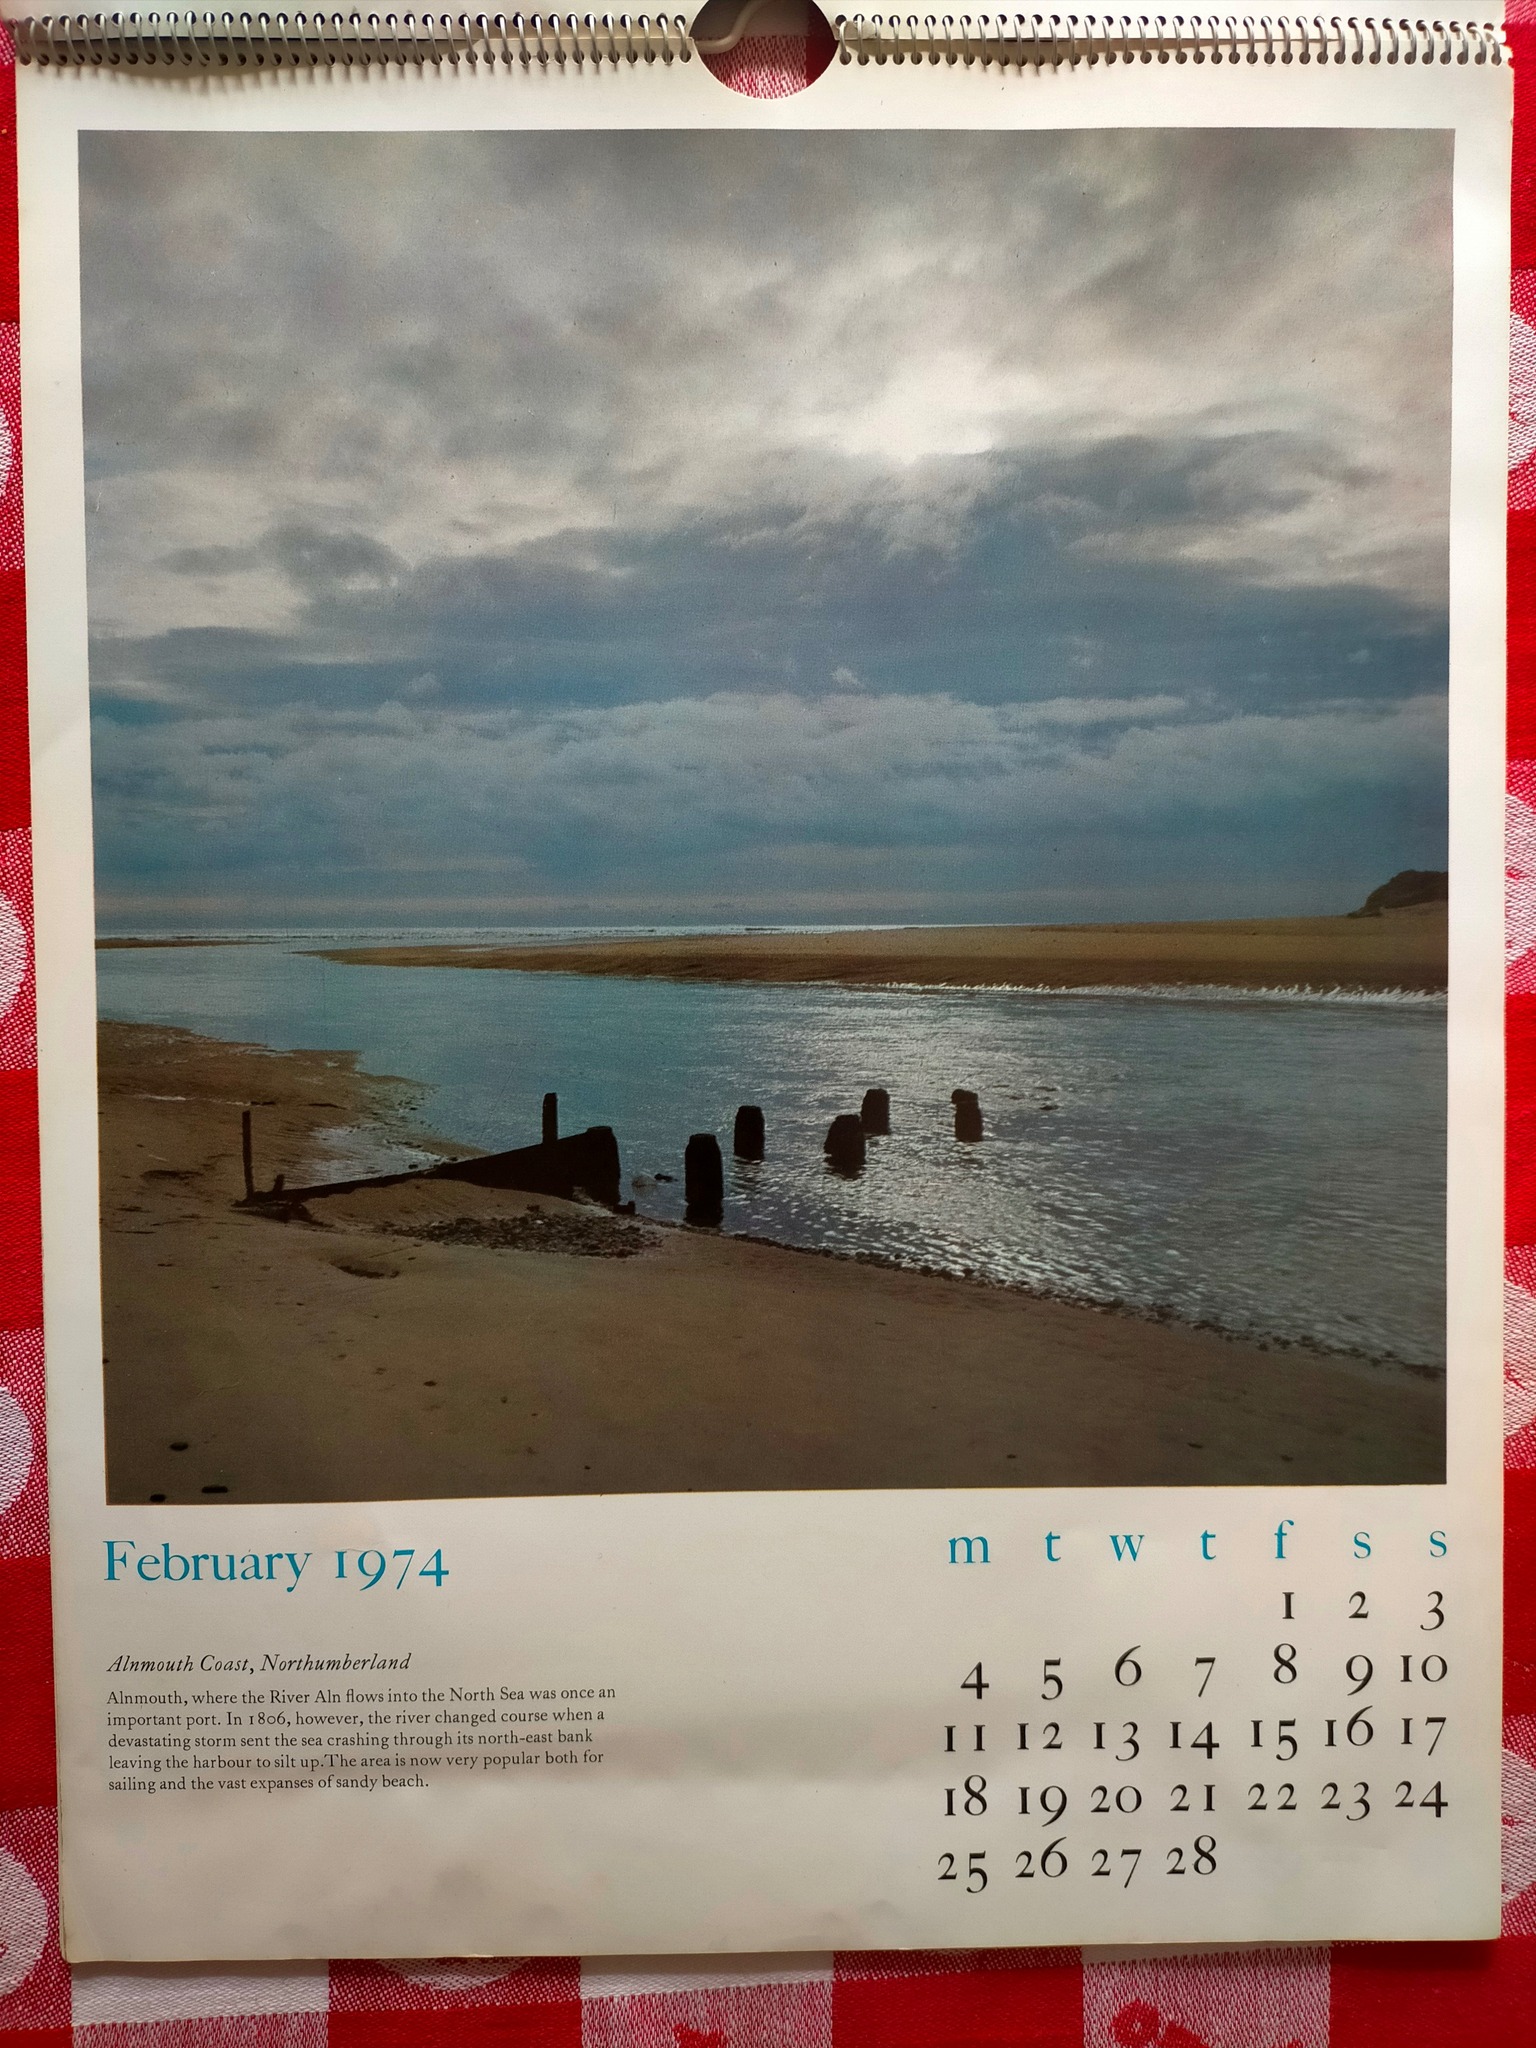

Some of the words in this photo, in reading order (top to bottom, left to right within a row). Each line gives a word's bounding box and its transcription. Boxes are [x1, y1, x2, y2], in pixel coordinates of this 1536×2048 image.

[948, 1536, 991, 1564] m
[1044, 1531, 1061, 1562] t
[1109, 1534, 1145, 1562] w
[1200, 1530, 1216, 1561] t
[1274, 1519, 1295, 1559] f
[1353, 1531, 1372, 1559] s
[1429, 1530, 1447, 1558] s
[103, 1540, 313, 1593] February
[335, 1547, 450, 1591] 1974
[1282, 1591, 1295, 1620] 1
[1348, 1590, 1369, 1619] 2
[1419, 1590, 1445, 1631] 3
[106, 1655, 194, 1672] Alnmouth
[200, 1654, 255, 1675] Coast,
[259, 1652, 412, 1672] Northumberland
[960, 1661, 990, 1700] 4
[1041, 1657, 1063, 1701] 5
[1114, 1645, 1142, 1687] 6
[1194, 1656, 1216, 1698] 7
[1273, 1643, 1298, 1685] 8
[1345, 1654, 1374, 1696] 9
[1400, 1654, 1448, 1683] 10
[106, 1690, 188, 1707] Alnmouth,
[191, 1690, 238, 1704] where
[241, 1689, 265, 1704] the
[269, 1689, 310, 1704] River
[314, 1689, 341, 1704] Aln
[345, 1688, 384, 1703] flows
[387, 1688, 418, 1703] into
[421, 1687, 445, 1703] the
[449, 1686, 495, 1702] North
[500, 1686, 525, 1701] Sea
[529, 1689, 557, 1700] was
[560, 1688, 595, 1699] once
[598, 1688, 616, 1699] an
[107, 1711, 182, 1731] important
[186, 1714, 221, 1731] port.
[226, 1711, 243, 1726] In
[248, 1710, 291, 1728] 1806,
[295, 1711, 364, 1727] however,
[368, 1710, 392, 1725] the
[395, 1709, 431, 1724] river
[434, 1708, 497, 1728] changed
[500, 1712, 548, 1723] course
[552, 1706, 593, 1721] when
[596, 1710, 605, 1720] a
[944, 1724, 986, 1753] 11
[1017, 1721, 1063, 1751] 12
[1093, 1721, 1140, 1762] 13
[1169, 1721, 1220, 1760] 14
[1250, 1718, 1298, 1762] 15
[1324, 1705, 1374, 1747] 16
[1400, 1716, 1447, 1757] 17
[108, 1732, 192, 1752] devastating
[194, 1736, 237, 1747] storm
[240, 1735, 270, 1747] sent
[274, 1732, 298, 1747] the
[301, 1736, 323, 1747] sea
[326, 1732, 390, 1750] crashing
[393, 1731, 453, 1750] through
[456, 1730, 474, 1745] its
[478, 1729, 553, 1745] north-east
[557, 1728, 593, 1743] bank
[109, 1754, 162, 1773] leaving
[165, 1754, 189, 1769] the
[193, 1754, 252, 1769] harbour
[256, 1756, 271, 1769] to
[274, 1753, 297, 1769] silt
[360, 1757, 392, 1767] area
[395, 1752, 407, 1767] is
[409, 1757, 442, 1767] now
[446, 1756, 479, 1770] very
[482, 1751, 541, 1770] popular
[545, 1750, 579, 1765] both
[583, 1749, 604, 1763] for
[108, 1776, 157, 1795] sailing
[159, 1775, 187, 1790] and
[190, 1776, 214, 1790] the
[217, 1778, 247, 1790] vast
[250, 1778, 314, 1794] expanses
[317, 1773, 335, 1788] of
[335, 1774, 379, 1792] sandy
[381, 1773, 429, 1788] beach.
[944, 1774, 988, 1817] 18
[1018, 1785, 1068, 1828] 19
[1090, 1785, 1143, 1814] 20
[1170, 1783, 1216, 1812] 21
[1247, 1782, 1298, 1811] 22
[1320, 1781, 1371, 1822] 23
[1394, 1780, 1449, 1819] 24
[937, 1850, 988, 1894] 25
[1015, 1836, 1068, 1878] 26
[1091, 1848, 1142, 1889] 27
[1166, 1834, 1217, 1876] 28
